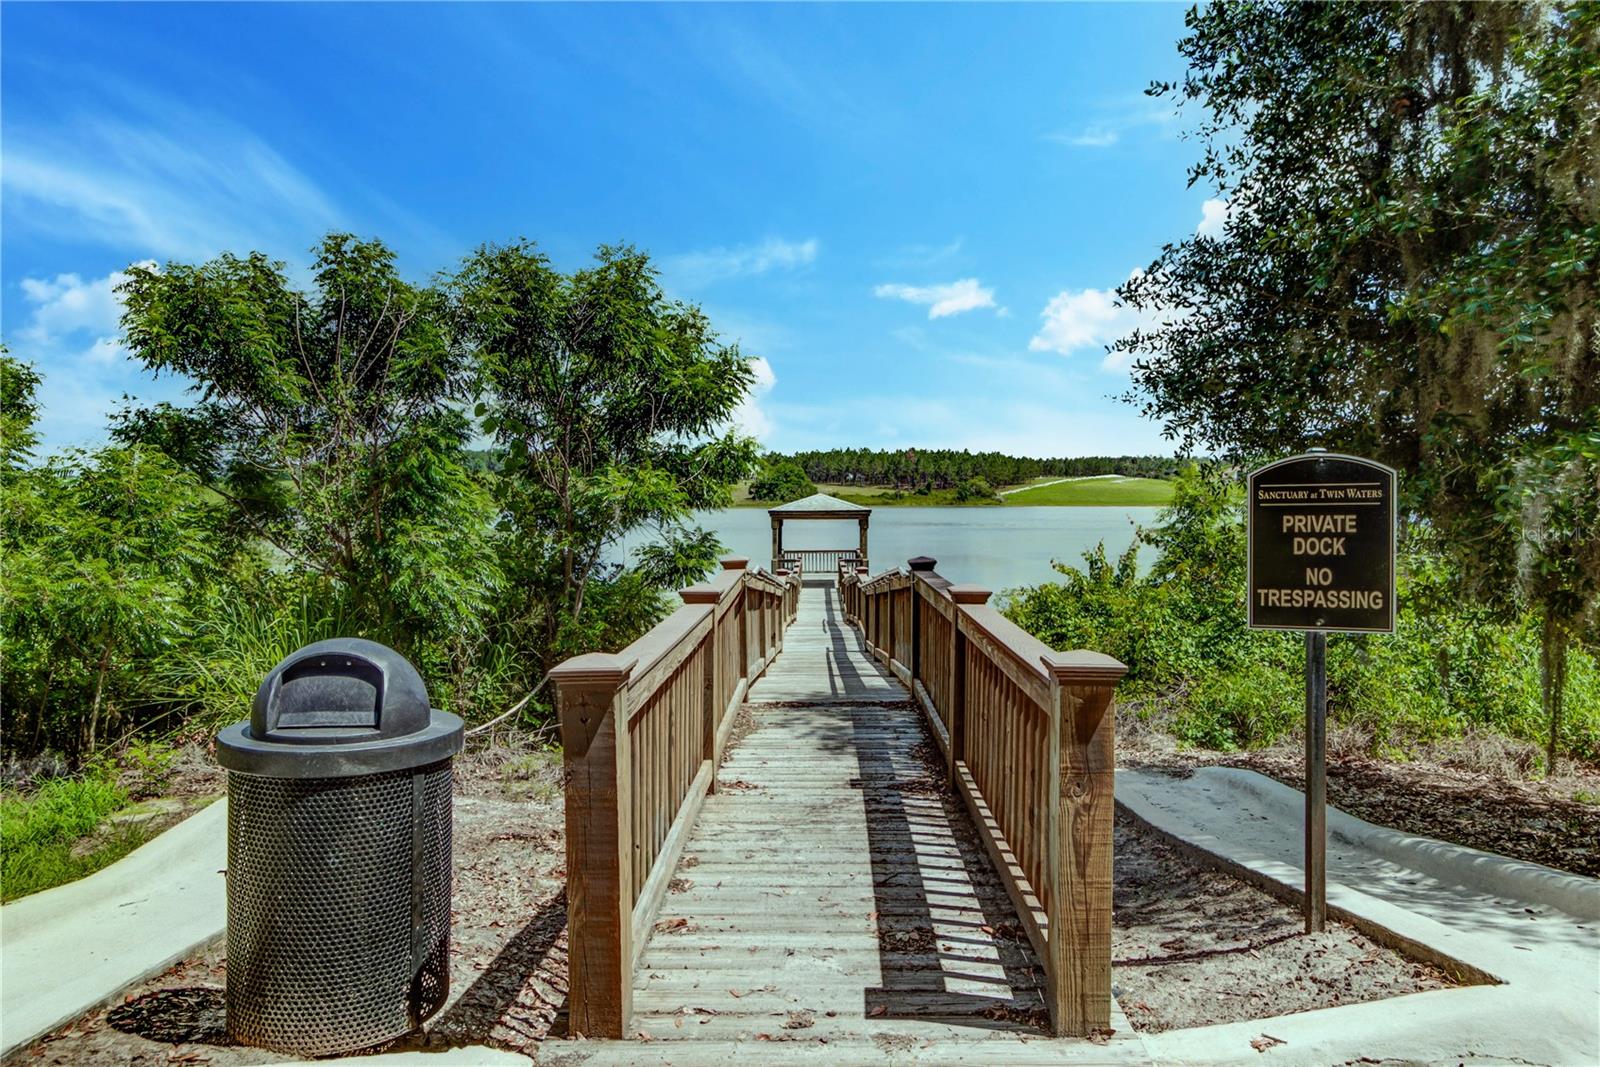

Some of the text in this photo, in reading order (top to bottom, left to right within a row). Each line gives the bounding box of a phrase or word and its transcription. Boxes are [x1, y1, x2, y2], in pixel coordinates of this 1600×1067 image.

[1258, 489, 1309, 500] SANCTUARY
[1319, 488, 1345, 499] TWIN
[1346, 488, 1383, 498] WATERS
[1283, 515, 1357, 533] PRIVATE
[1293, 537, 1346, 556] DOCK
[1306, 567, 1333, 586] NO
[1257, 589, 1383, 610] TRESPASSING
